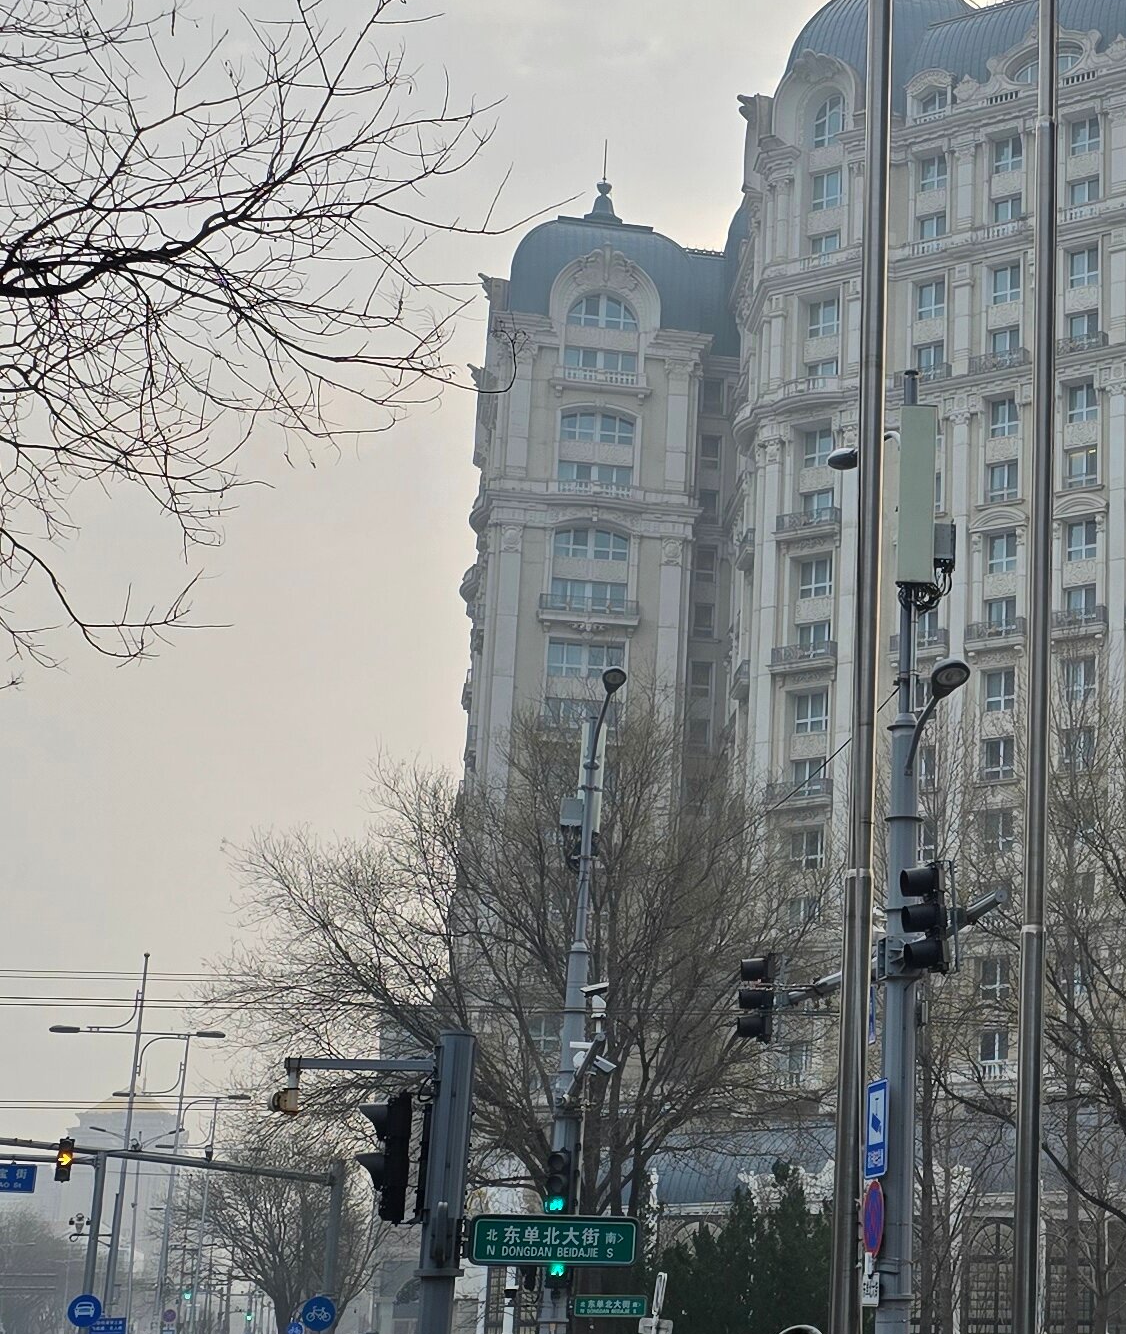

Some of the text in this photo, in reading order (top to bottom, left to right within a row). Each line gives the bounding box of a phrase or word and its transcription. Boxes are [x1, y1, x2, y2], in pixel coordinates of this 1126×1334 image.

[486, 1225, 617, 1246] 北 东单北大街 南
[486, 1244, 614, 1259] N DONGDAN BEIDAJIE S
